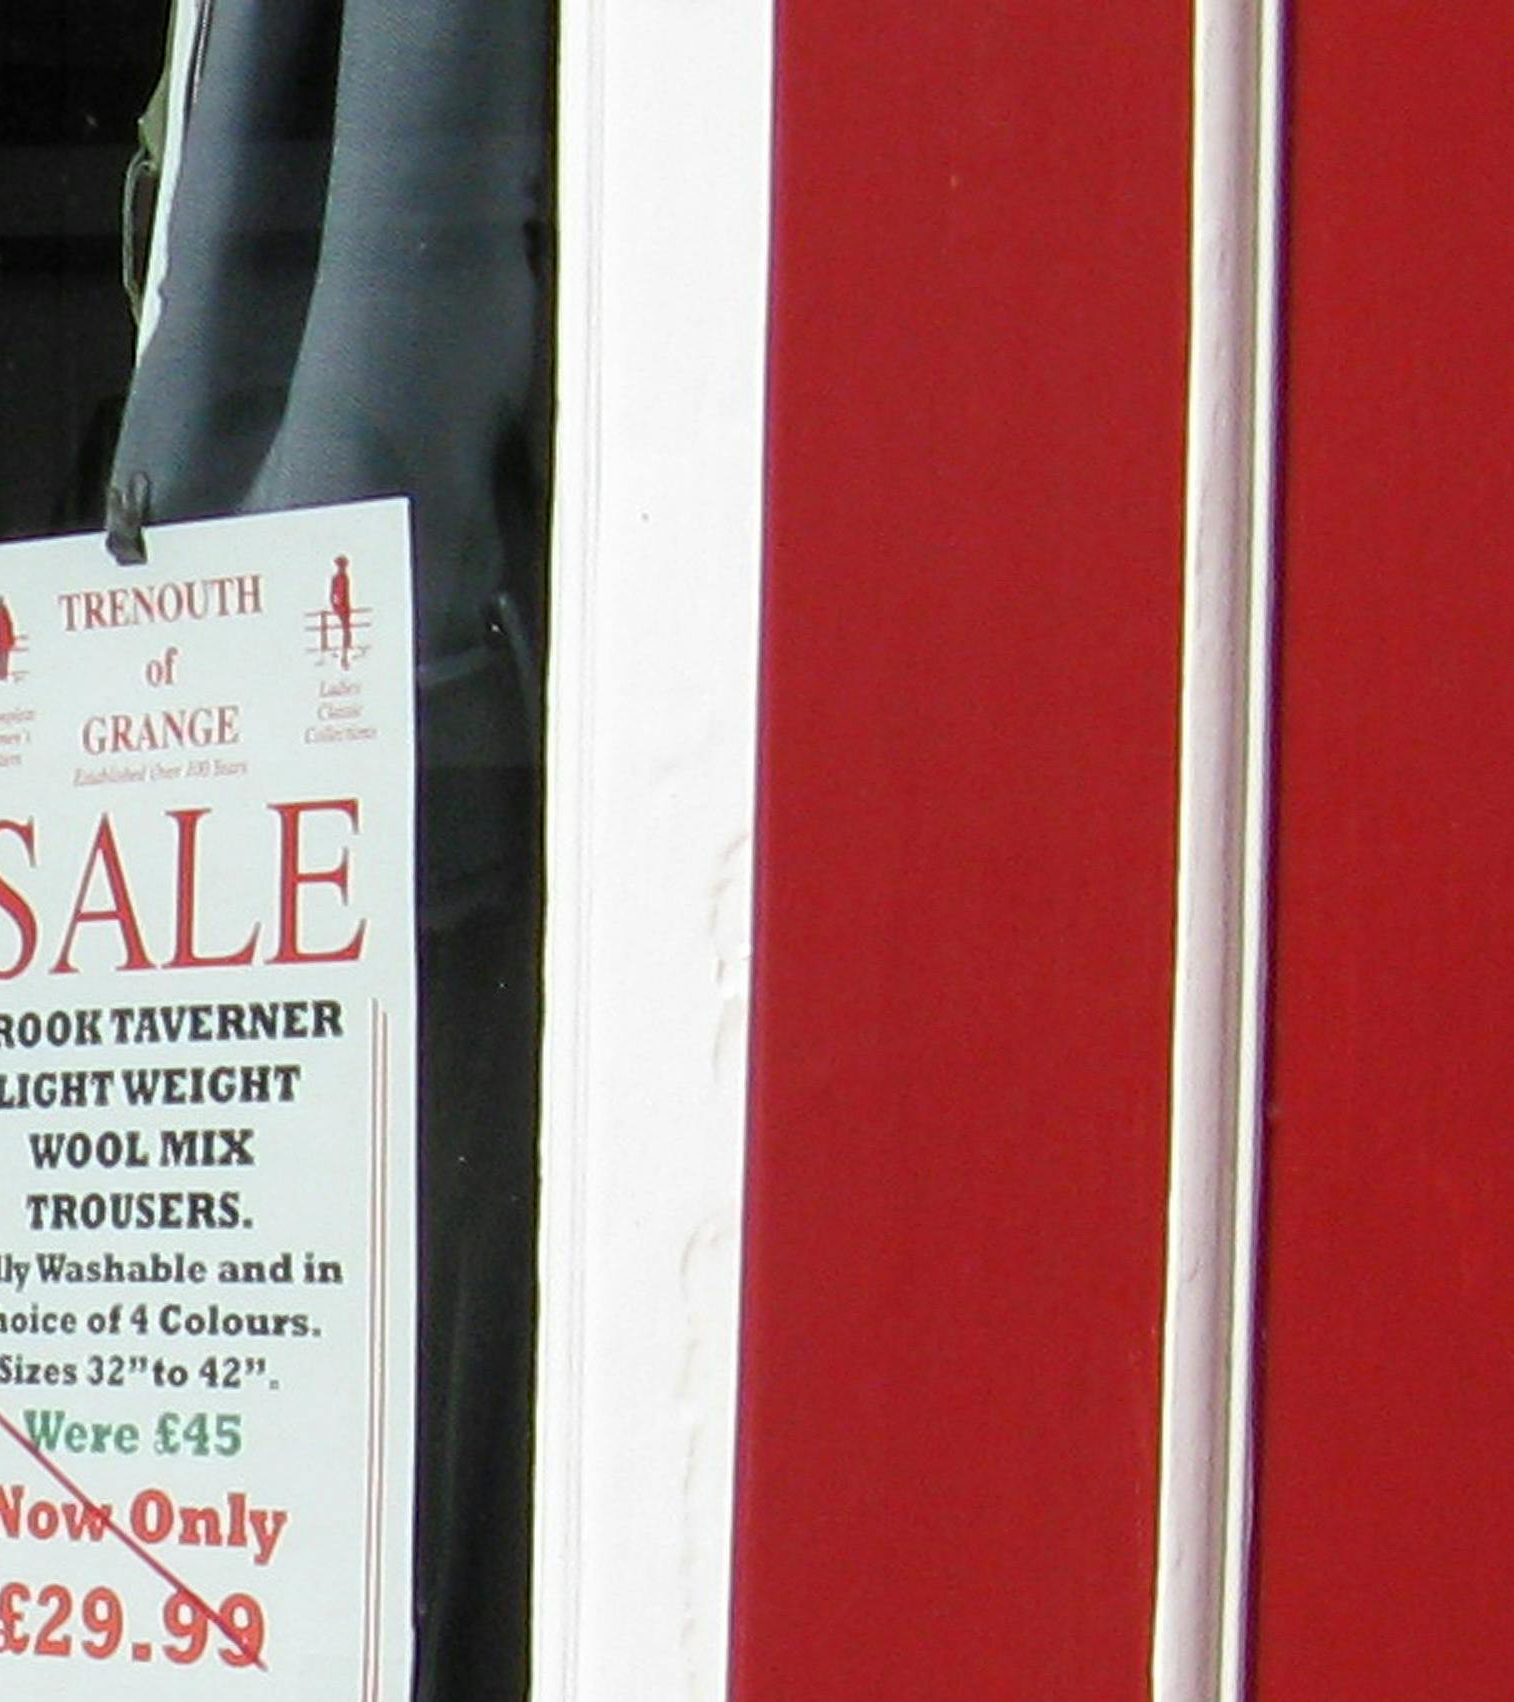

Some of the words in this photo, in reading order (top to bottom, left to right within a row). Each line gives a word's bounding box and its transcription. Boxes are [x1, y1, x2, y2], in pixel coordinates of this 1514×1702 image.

[57, 572, 264, 634] TRENOUTH
[144, 646, 179, 687] of
[81, 705, 240, 756] GRANGE
[110, 999, 344, 1043] TAVERNER
[121, 1064, 302, 1106] WEIGHT
[29, 1131, 149, 1169] WOOL
[159, 1128, 255, 1167] MIX
[25, 1192, 254, 1231] TROUSERS.
[35, 1252, 207, 1284] Washable
[217, 1252, 293, 1285] and
[303, 1252, 344, 1284] in
[86, 1303, 124, 1336] of
[129, 1305, 149, 1336] 4
[158, 1304, 322, 1338] Colours.
[22, 1409, 141, 1454] Were
[153, 1411, 244, 1458] £45
[129, 1488, 288, 1567] Only
